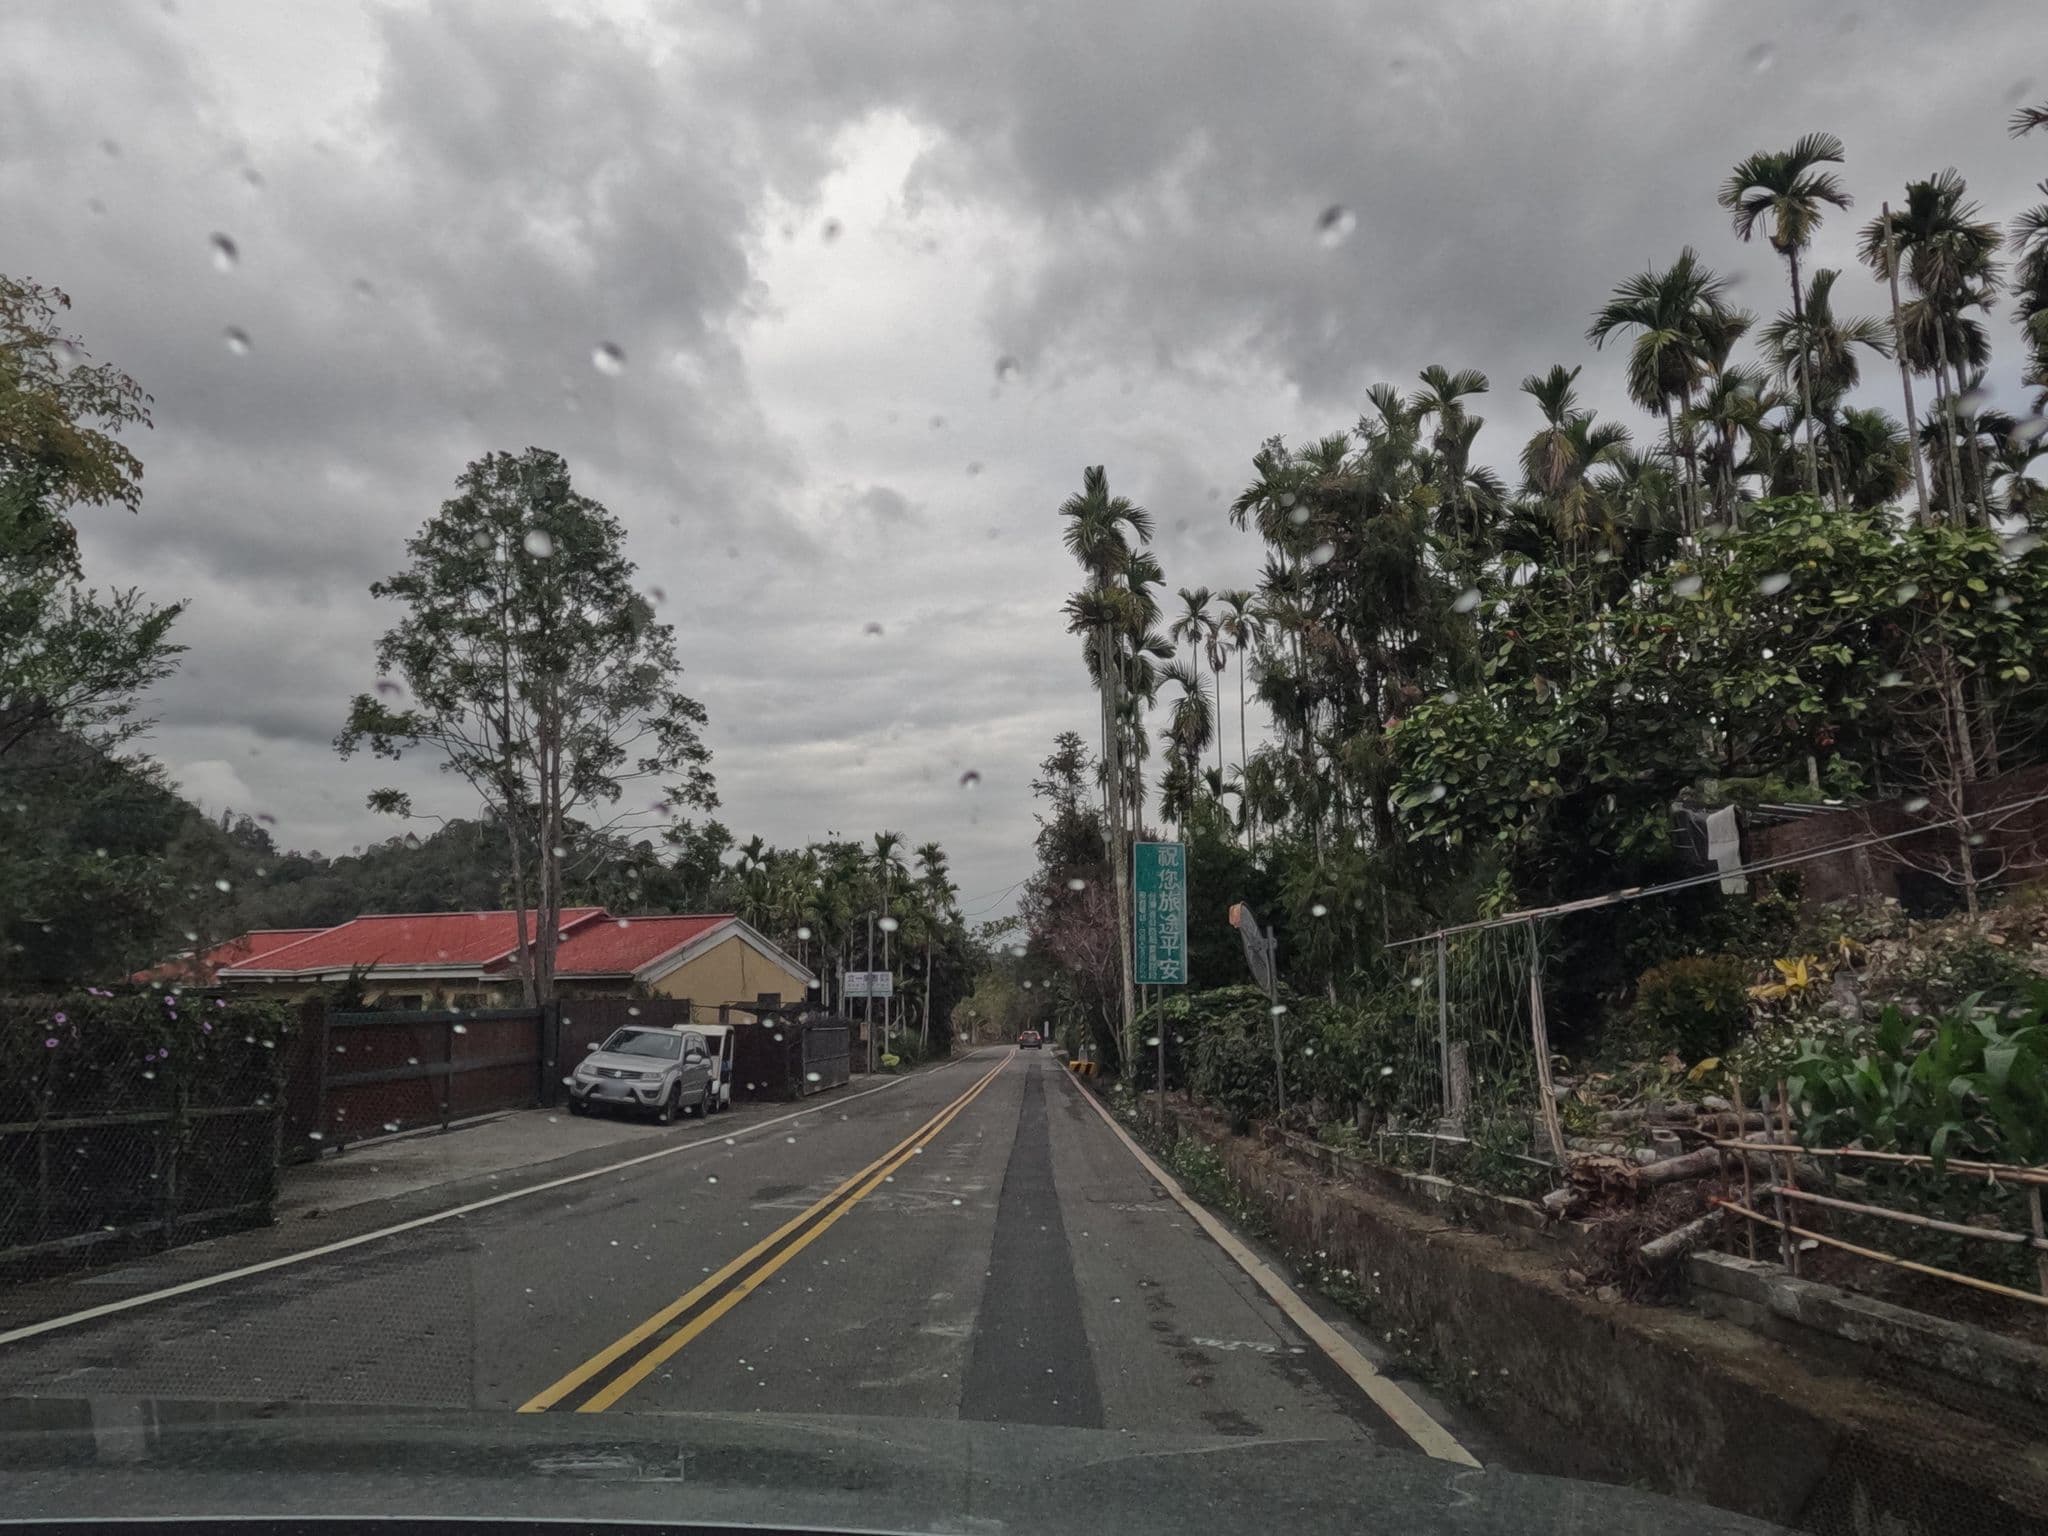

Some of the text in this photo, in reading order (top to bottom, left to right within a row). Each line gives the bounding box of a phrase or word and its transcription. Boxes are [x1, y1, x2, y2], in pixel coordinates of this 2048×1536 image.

[1157, 846, 1180, 980] 祝您旅途平安
